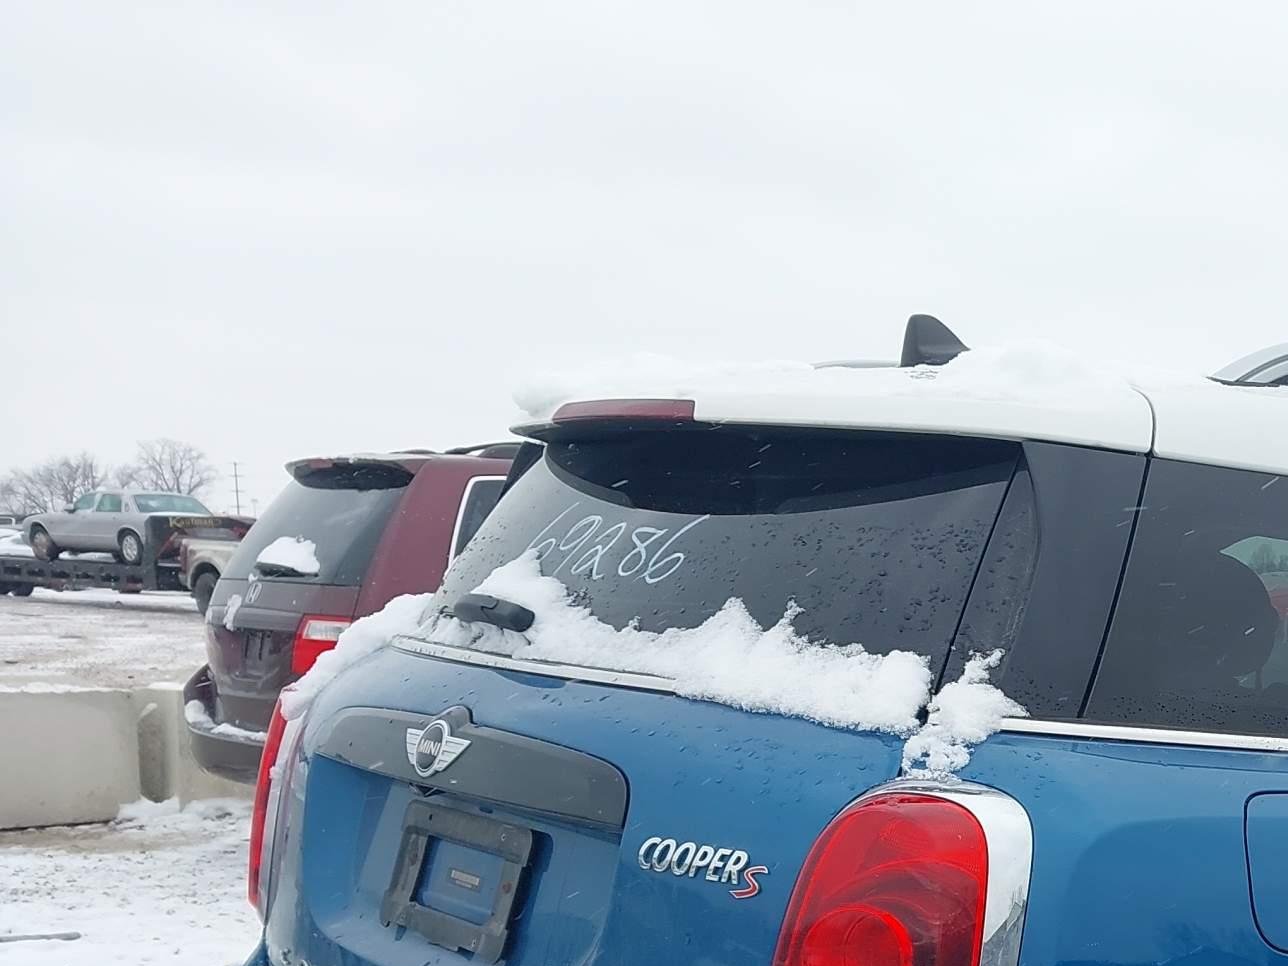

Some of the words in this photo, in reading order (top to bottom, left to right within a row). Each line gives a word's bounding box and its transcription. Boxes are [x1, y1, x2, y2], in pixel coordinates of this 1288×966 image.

[527, 502, 711, 584] 69286
[417, 738, 442, 757] MINI
[638, 836, 749, 885] COOPER
[729, 865, 769, 899] S
